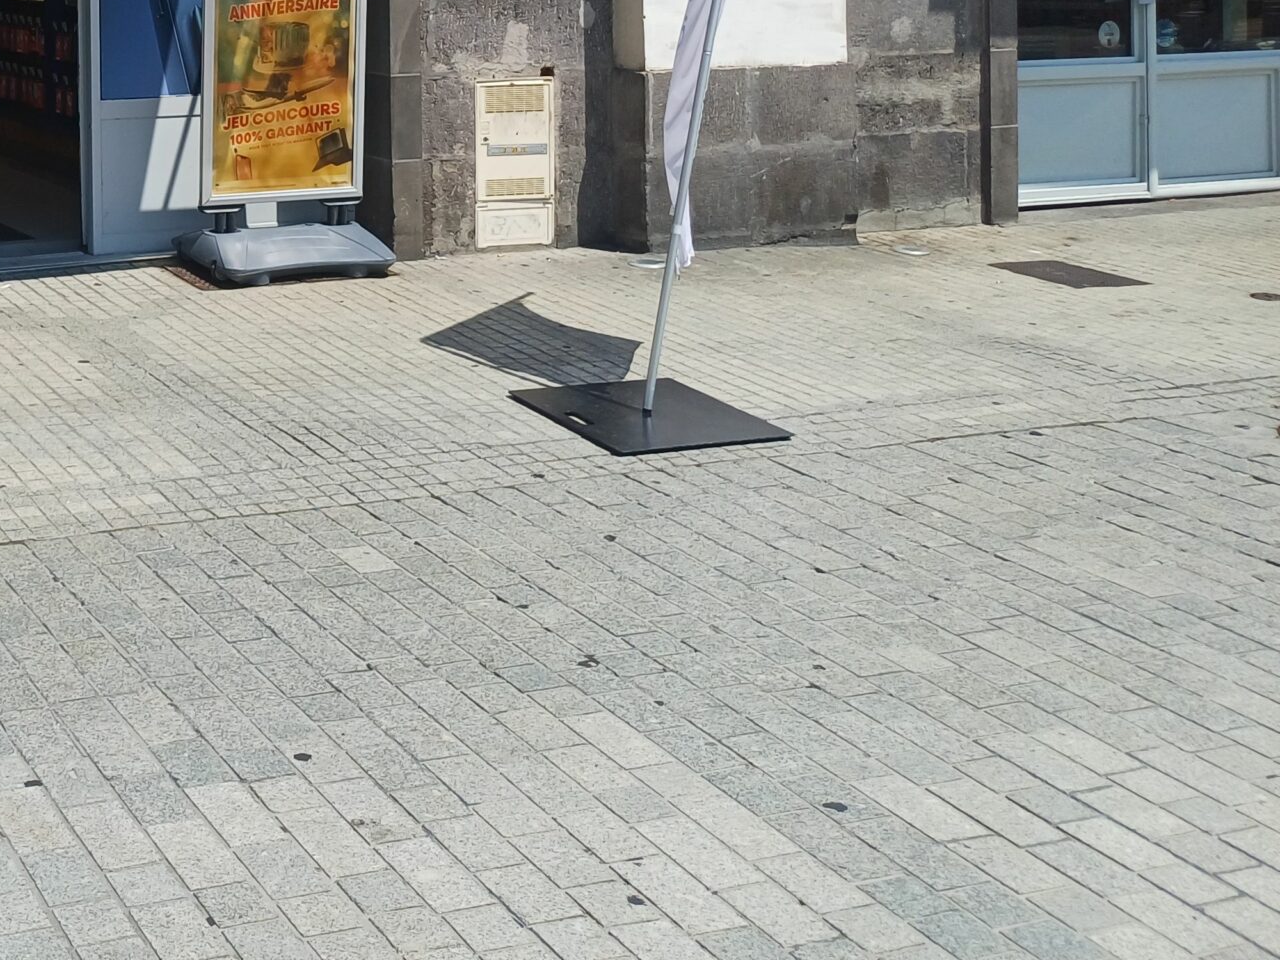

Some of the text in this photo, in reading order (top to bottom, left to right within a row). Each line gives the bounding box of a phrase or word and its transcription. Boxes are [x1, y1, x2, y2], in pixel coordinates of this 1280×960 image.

[223, 102, 340, 130] JEU CONCOURS
[230, 131, 262, 145] 100%
[266, 120, 332, 139] GAGNANT
